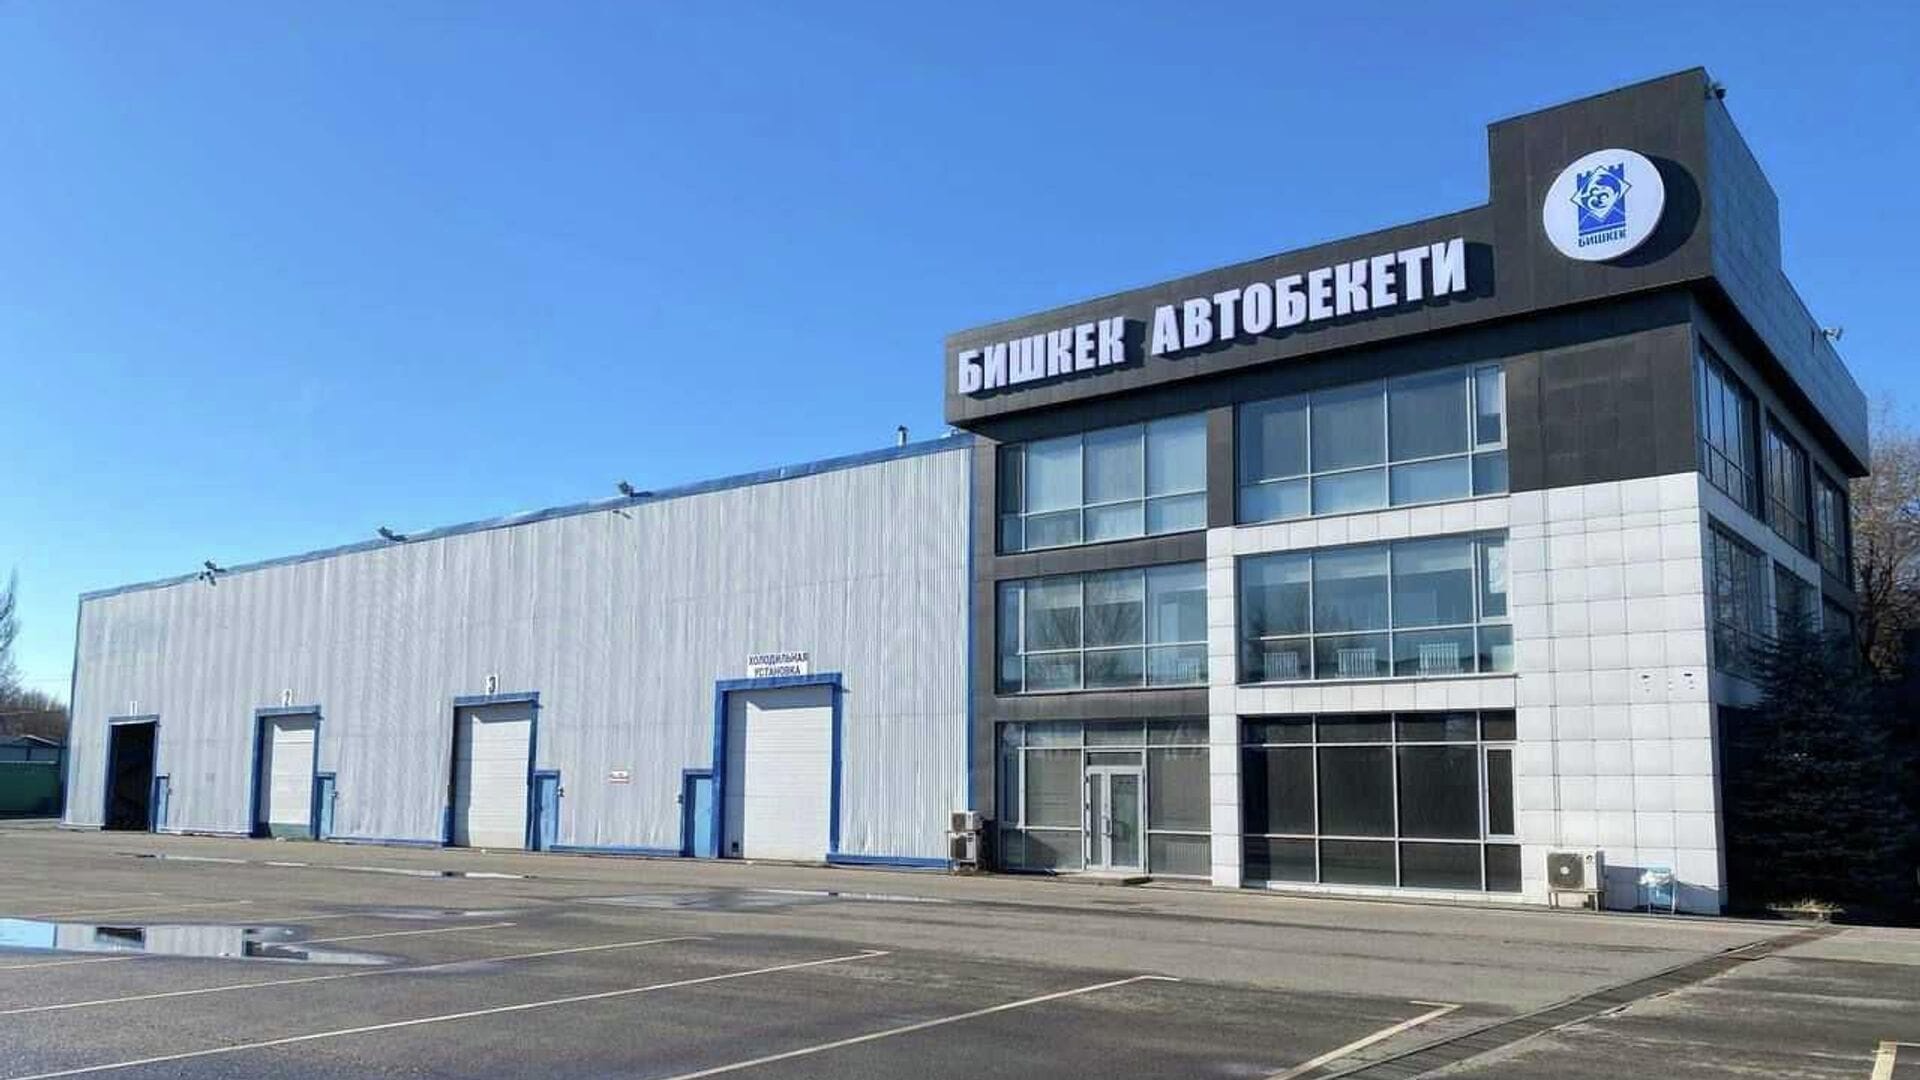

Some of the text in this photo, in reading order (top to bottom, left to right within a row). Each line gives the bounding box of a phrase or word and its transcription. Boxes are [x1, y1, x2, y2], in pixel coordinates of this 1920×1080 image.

[958, 237, 1467, 395] БИШКЕК АВТОБЕКЕТИ
[748, 652, 808, 666] ХОЛОДИЛЬНАЯ
[755, 665, 801, 676] УСТАНОВКА
